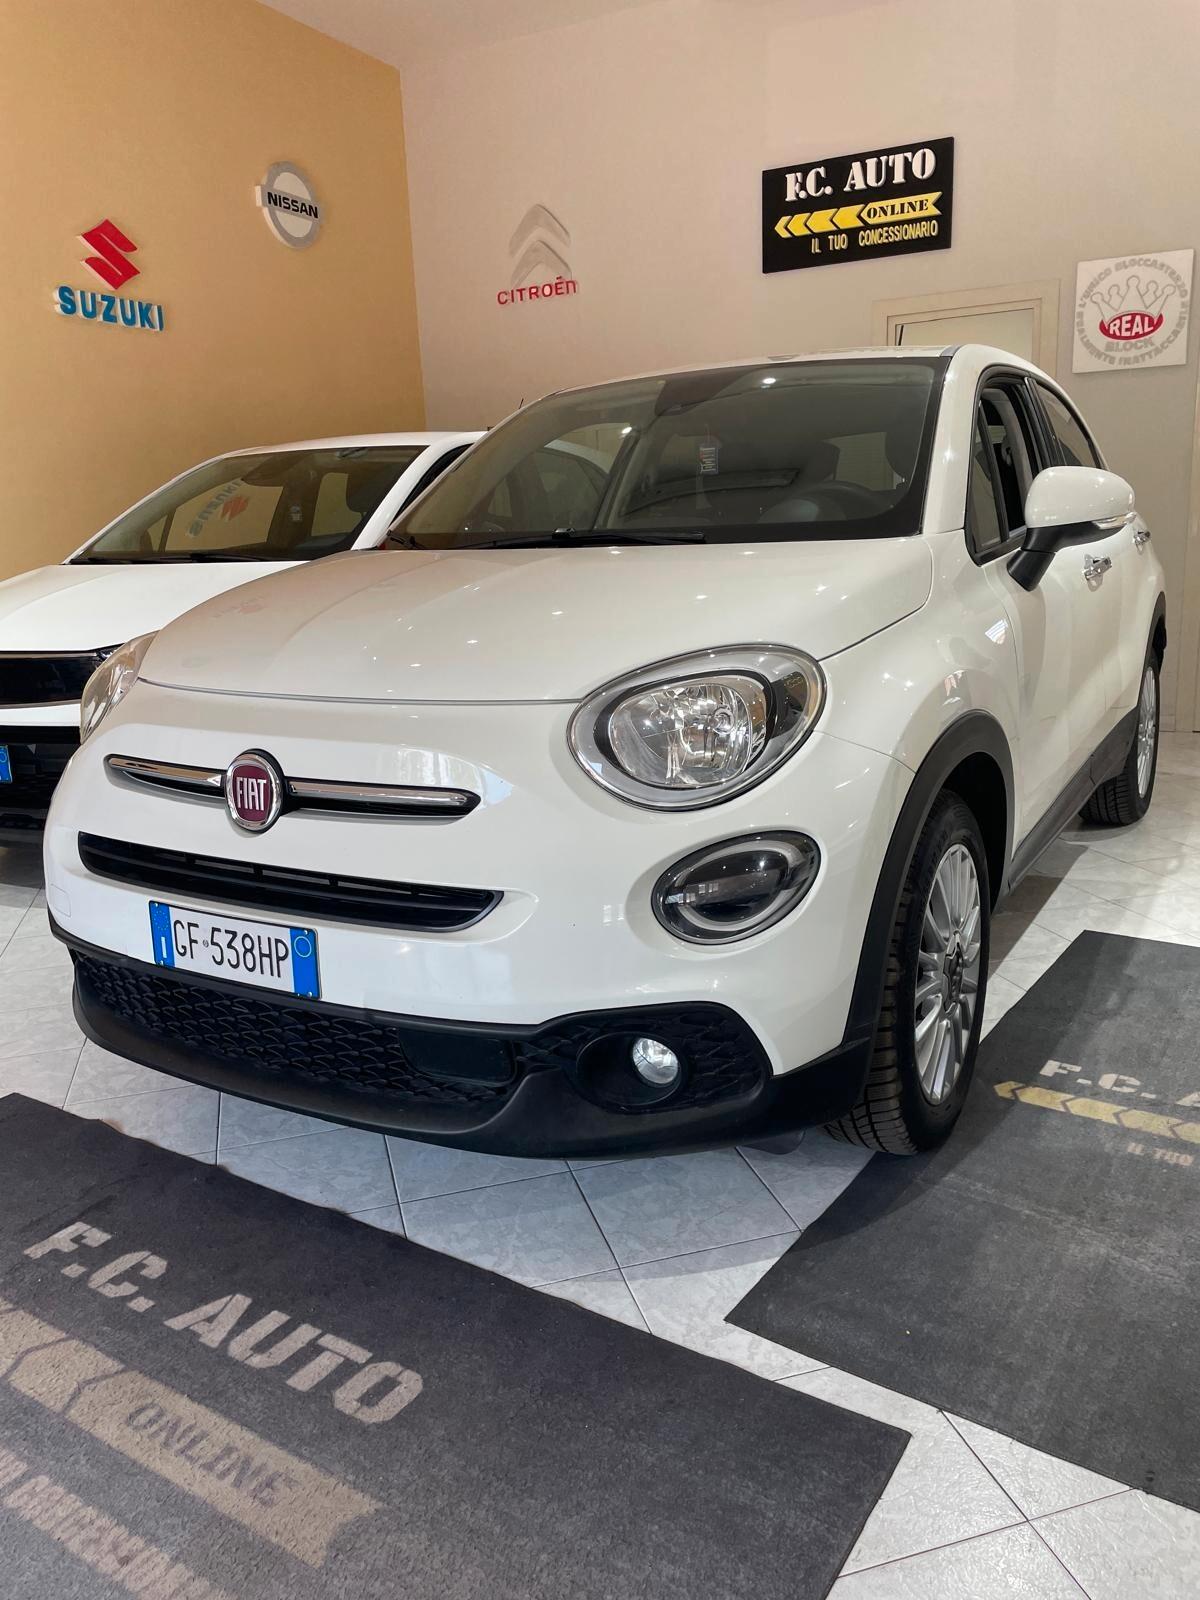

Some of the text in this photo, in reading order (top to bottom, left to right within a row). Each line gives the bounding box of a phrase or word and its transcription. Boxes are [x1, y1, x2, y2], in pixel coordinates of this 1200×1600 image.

[785, 148, 936, 202] F.C. AUTO
[267, 191, 319, 219] NISSAN
[866, 198, 929, 219] ONLINE
[811, 220, 938, 254] IL TUO CONCESSIONARIO
[56, 285, 164, 332] SUZUKI
[1109, 315, 1154, 337] REAL
[1103, 338, 1156, 353] BLOCK
[236, 776, 267, 811] FIAT
[1040, 1059, 1156, 1099] F.C.
[23, 1221, 424, 1425] F.C. AUTO
[126, 1401, 300, 1508] ONLINE
